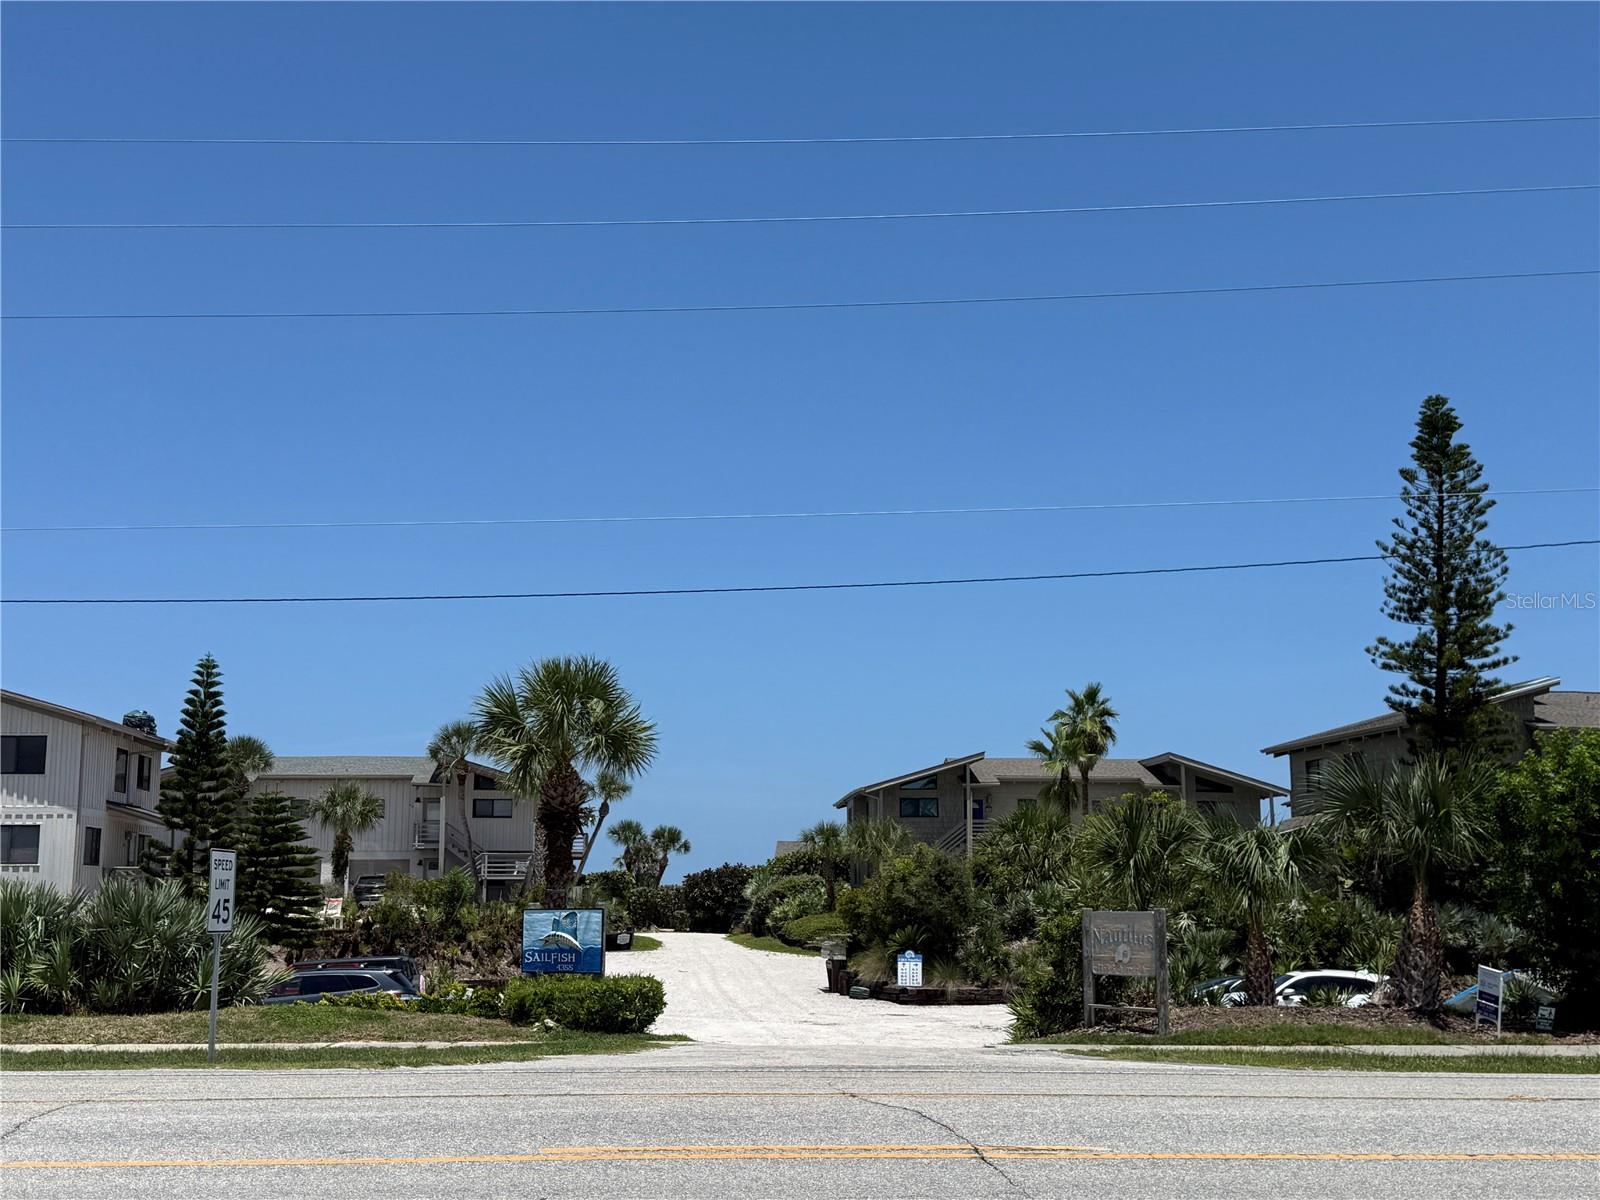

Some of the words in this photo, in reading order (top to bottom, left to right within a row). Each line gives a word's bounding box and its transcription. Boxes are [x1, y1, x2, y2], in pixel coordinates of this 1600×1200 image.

[213, 858, 233, 871] SPEED
[214, 878, 231, 890] LIMIT
[211, 898, 230, 924] 45
[1093, 924, 1153, 946] Nautilus
[524, 951, 576, 964] SAILFISH
